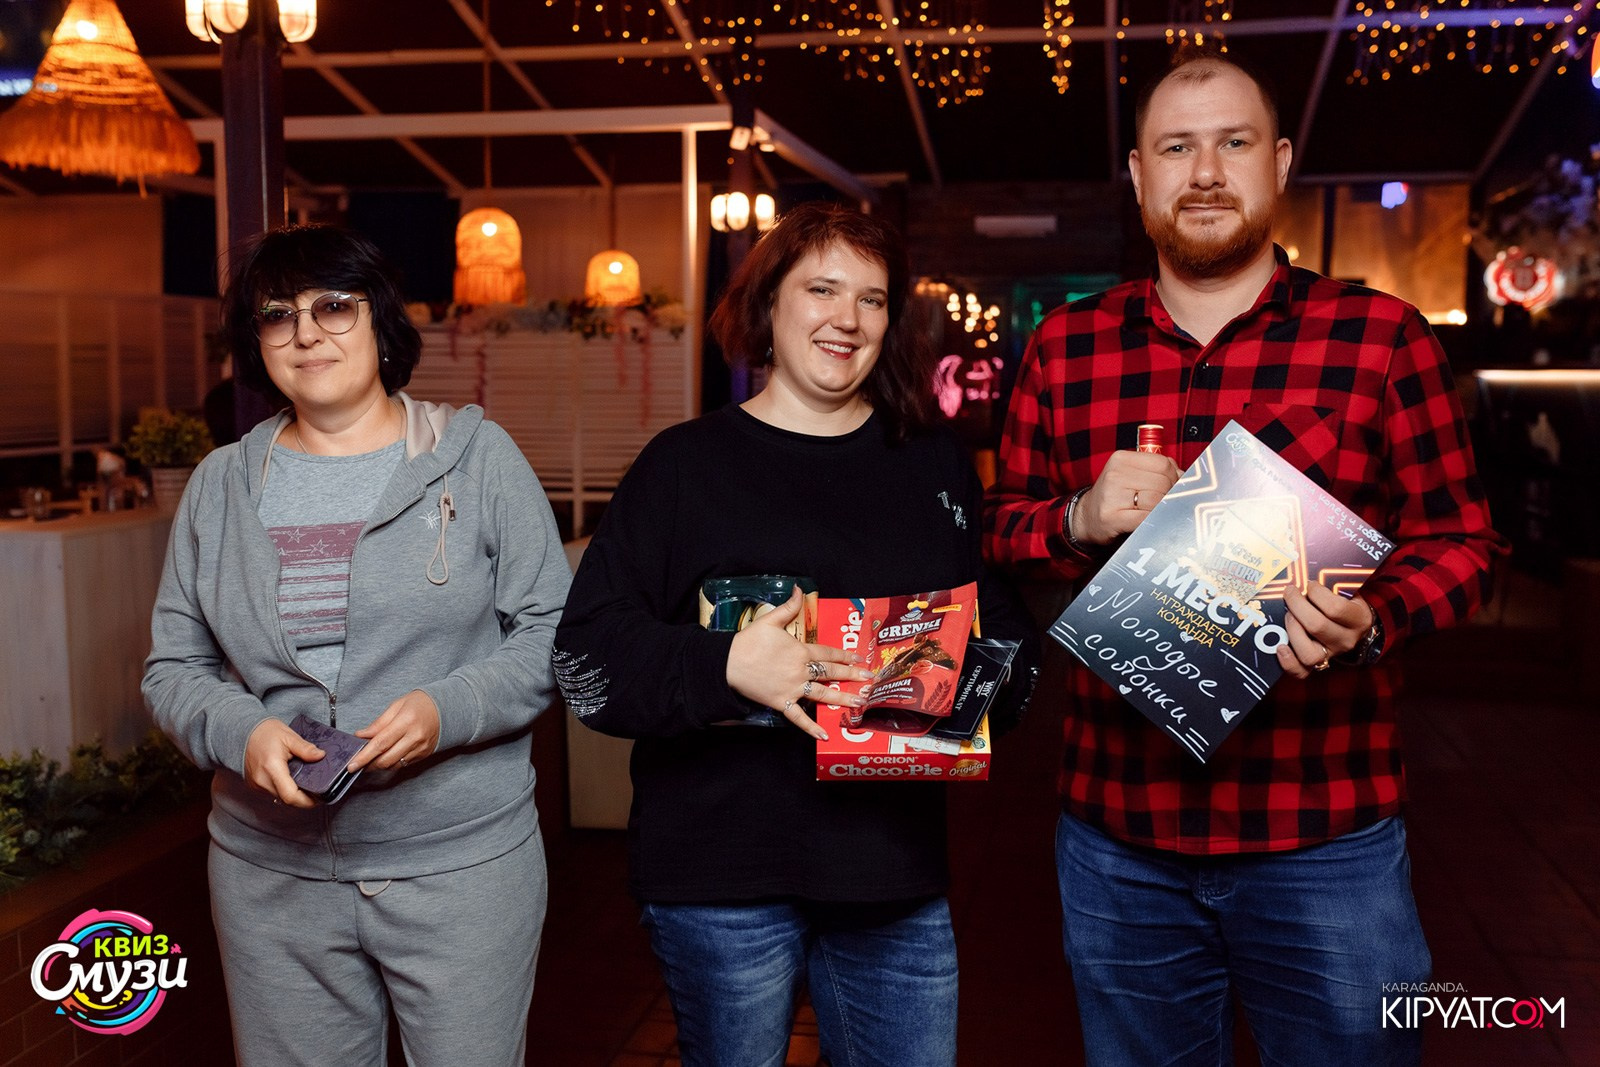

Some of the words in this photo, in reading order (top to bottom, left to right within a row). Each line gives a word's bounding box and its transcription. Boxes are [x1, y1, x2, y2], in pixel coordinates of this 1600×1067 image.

[1357, 524, 1392, 552] хоббит
[1206, 554, 1264, 582] OPCORN
[1126, 547, 1156, 576] 1
[1151, 566, 1288, 654] МЕСТО
[878, 618, 942, 640] GRENKI
[1150, 588, 1240, 648] НАГРАЖДАЕТСЯ
[1156, 606, 1214, 648] КОМАНДА
[955, 666, 982, 711] СЕРТИФИКАТ
[829, 764, 943, 777] Choco-Pie
[872, 756, 915, 764] ORION
[949, 761, 987, 776] Original
